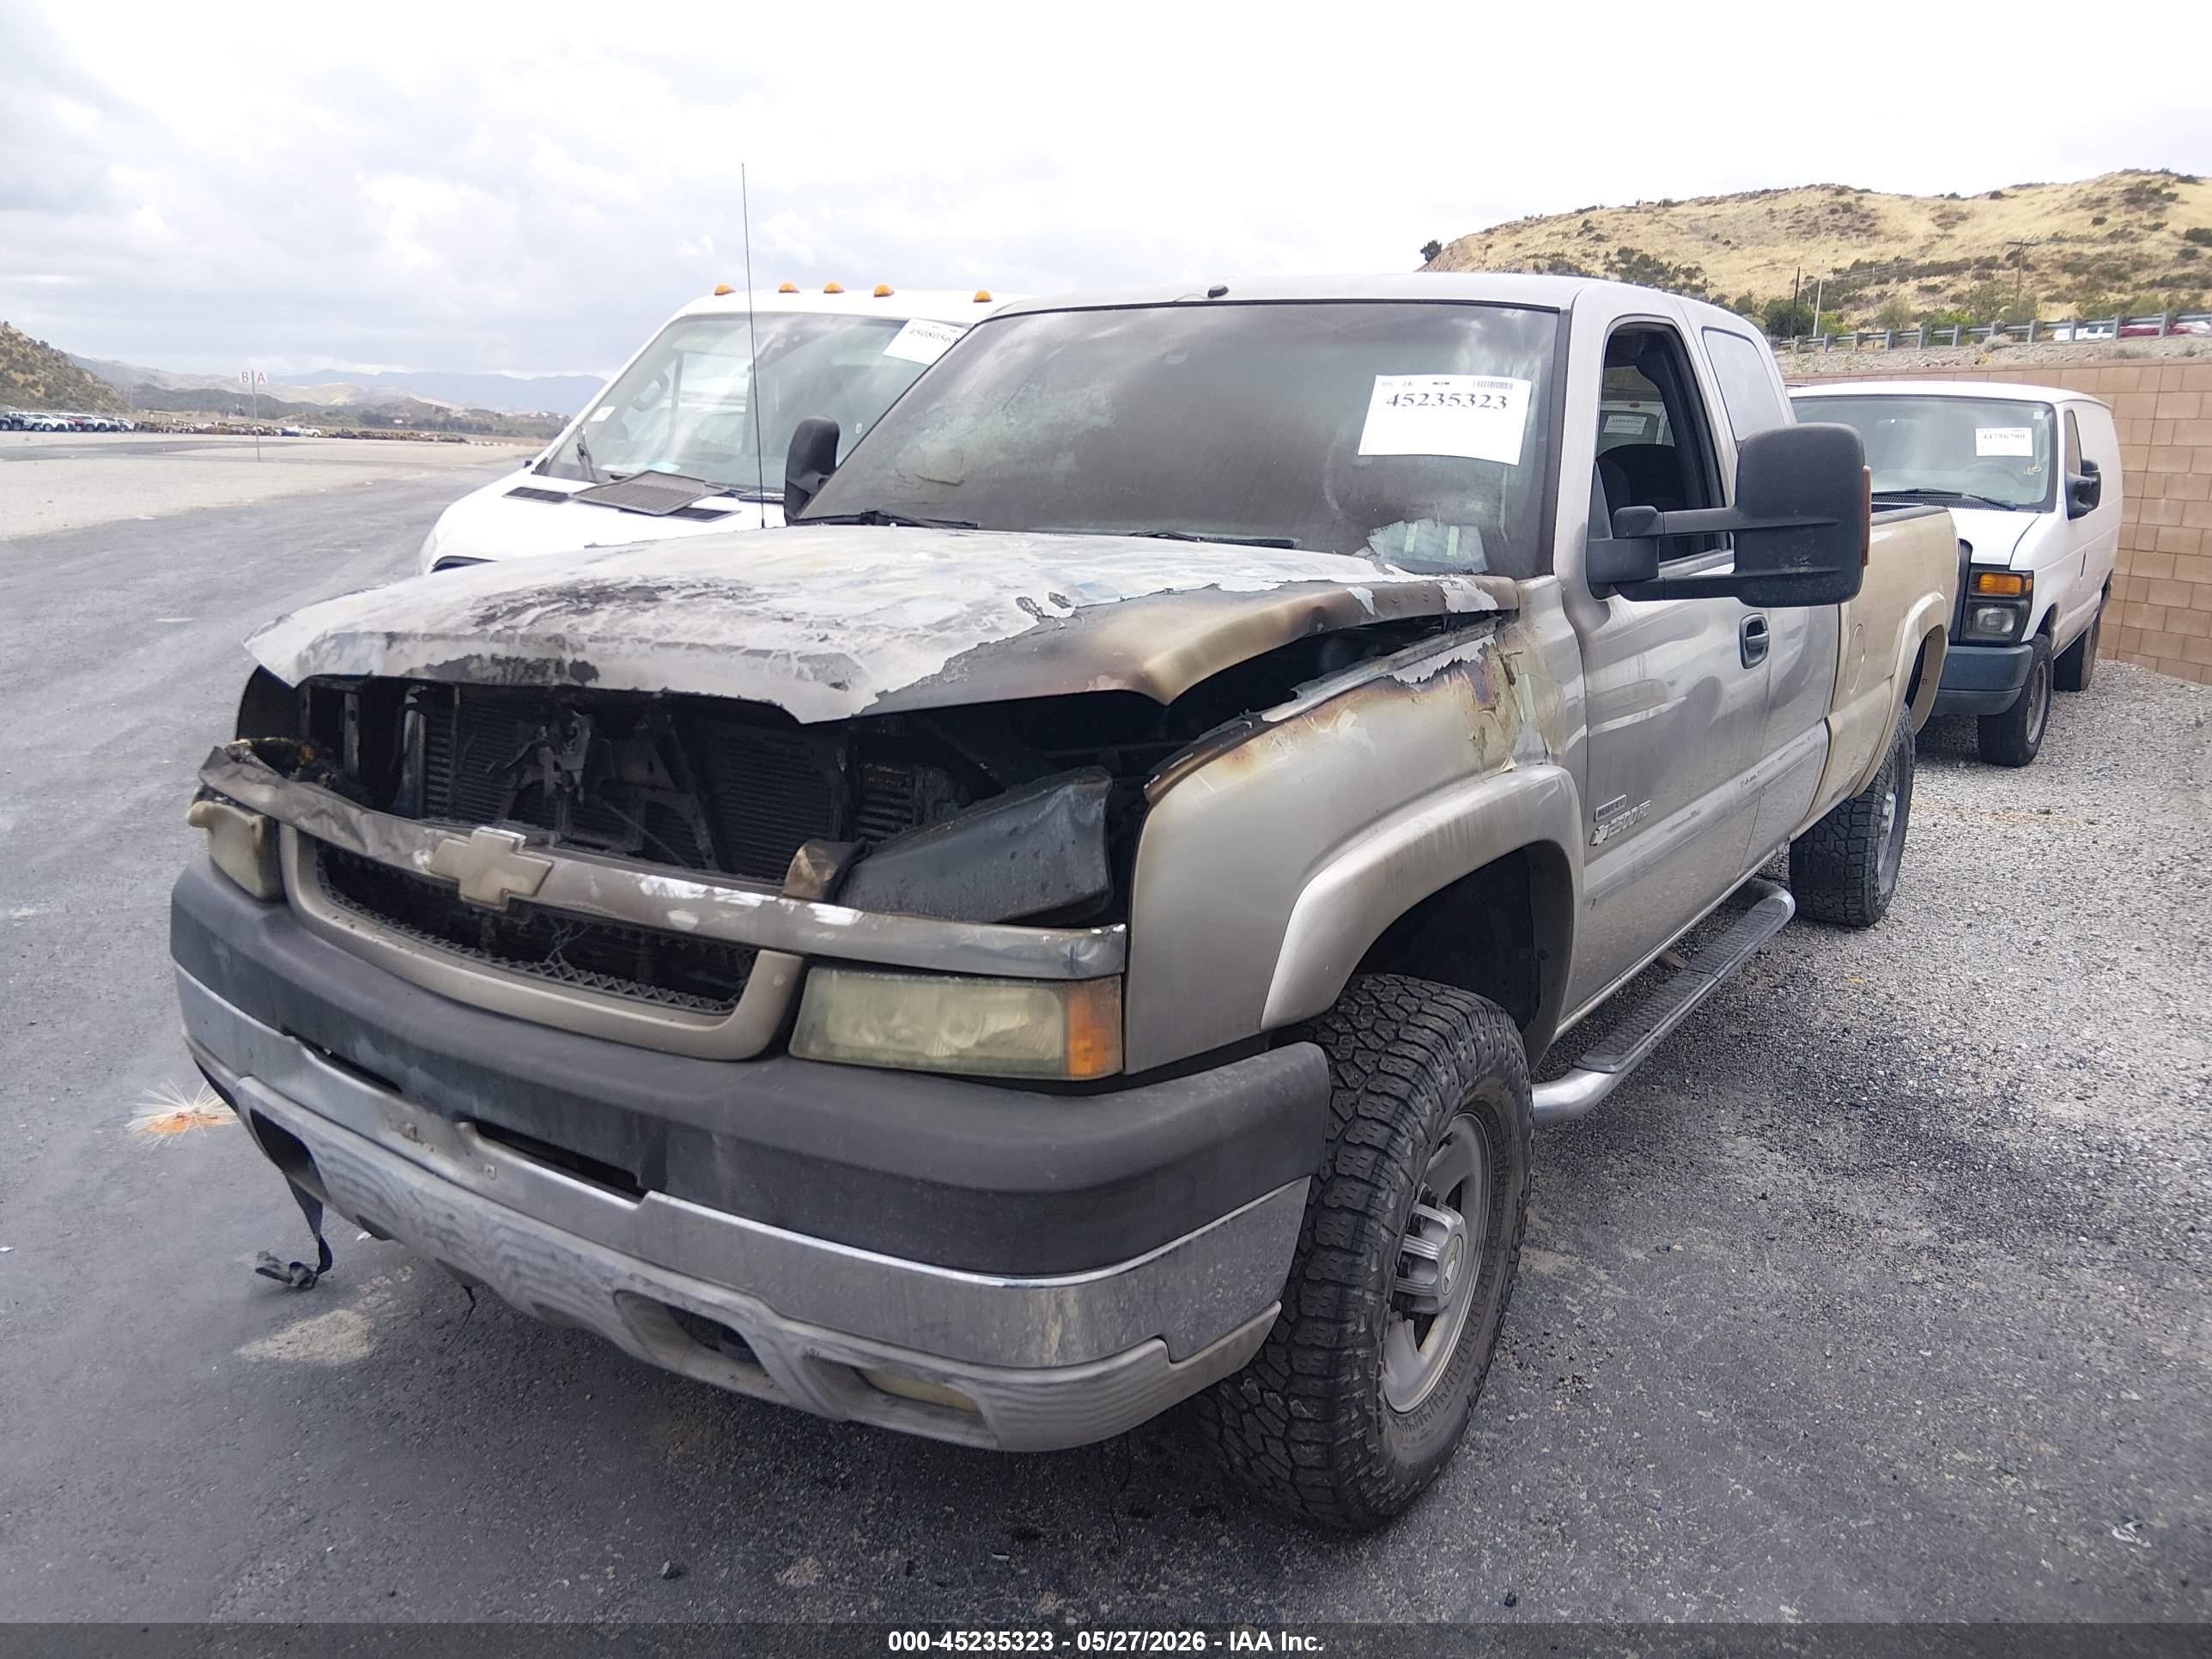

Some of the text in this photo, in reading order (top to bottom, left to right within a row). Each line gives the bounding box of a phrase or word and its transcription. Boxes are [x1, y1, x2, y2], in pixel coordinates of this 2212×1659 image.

[241, 371, 249, 384] B
[257, 371, 266, 384] A
[1386, 392, 1508, 410] 45235323
